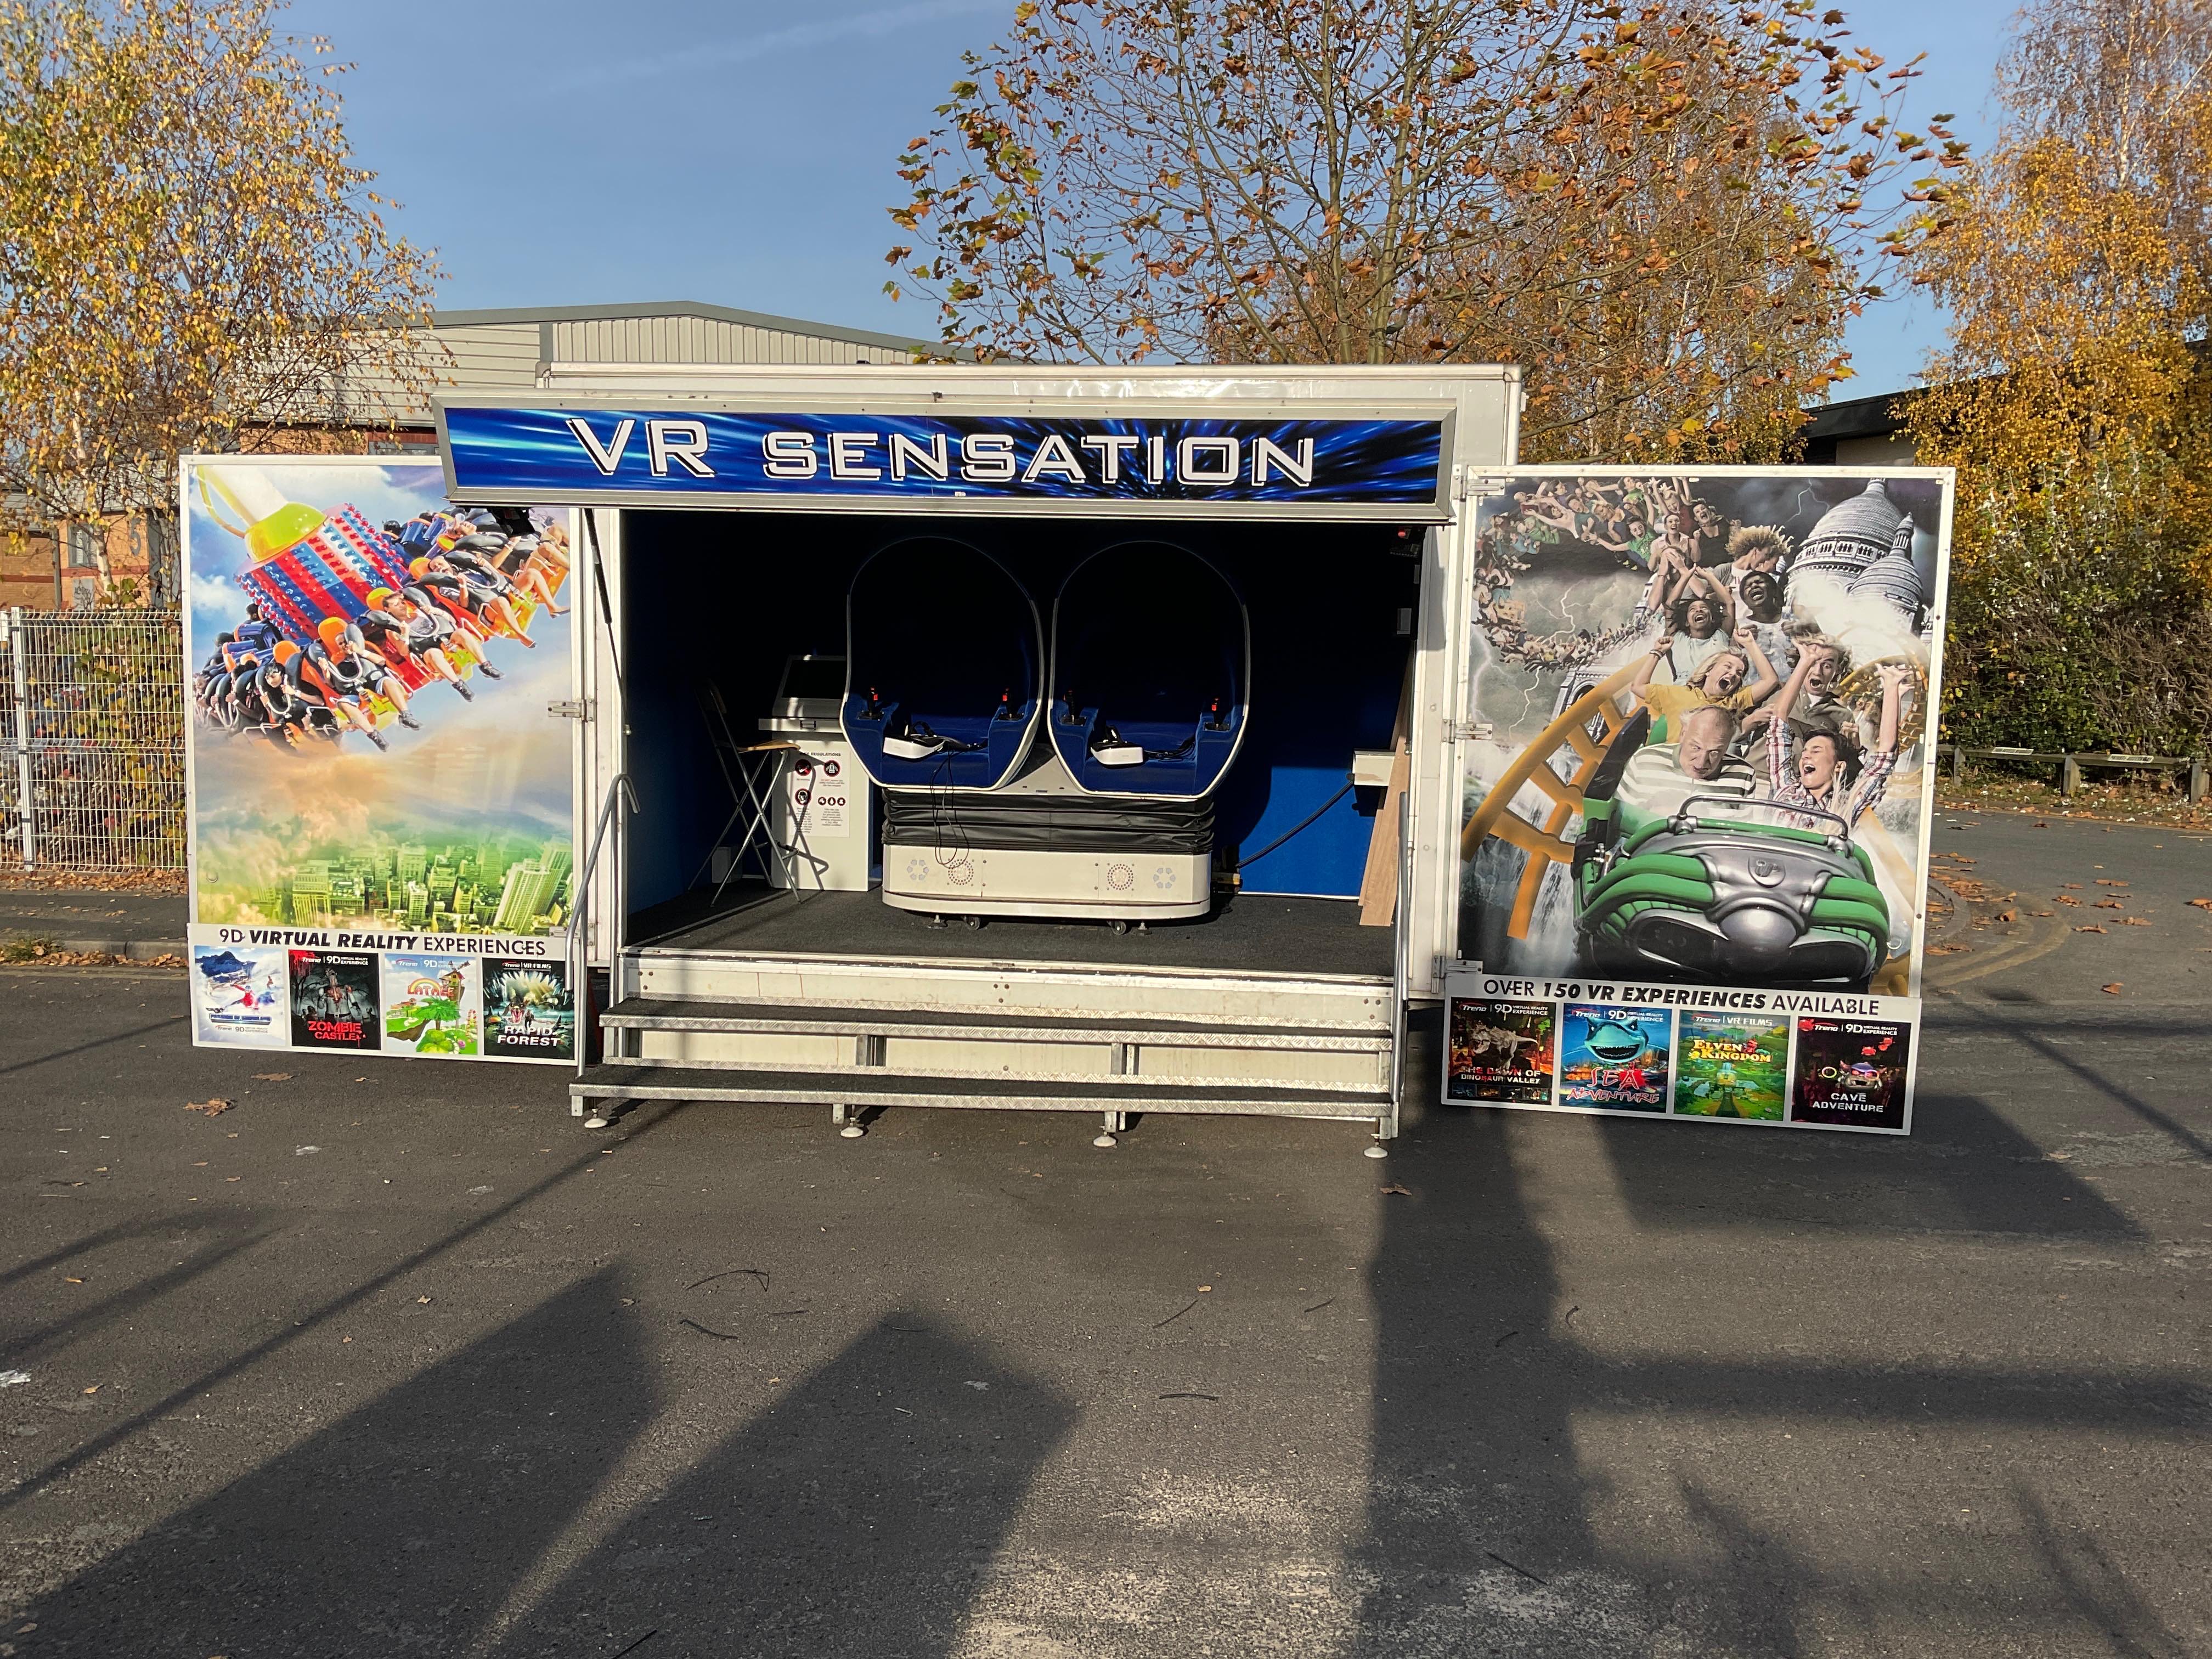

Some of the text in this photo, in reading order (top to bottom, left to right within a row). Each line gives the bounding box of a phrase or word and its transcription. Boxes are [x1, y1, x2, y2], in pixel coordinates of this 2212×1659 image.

[566, 417, 1314, 487] VR SENSATION
[219, 929, 545, 956] 9D VIRTUAL REALITY EXPERIENCES
[326, 956, 341, 964] 9D
[424, 960, 438, 968] 9D
[1484, 979, 1879, 1016] OVER 150 VR EXPERIENCES AVAILABLE
[1494, 1003, 1513, 1013] 9D
[1608, 1010, 1627, 1020] 9D
[307, 1020, 362, 1032] ZOMBIE
[504, 1025, 553, 1036] RAPID
[1846, 1024, 1863, 1033] 9D
[314, 1031, 357, 1041] CASTLE
[497, 1035, 561, 1047] FOREST
[1693, 1039, 1743, 1051] ELVEN
[1700, 1048, 1771, 1063] KINGDOM
[1487, 1067, 1522, 1076] DAWN
[1461, 1074, 1504, 1082] DINOSAUR
[1587, 1066, 1639, 1091] SEA
[1566, 1087, 1660, 1104] ADVENTURE
[1831, 1092, 1866, 1102] CAVE
[1812, 1101, 1884, 1113] ADVENTURE
